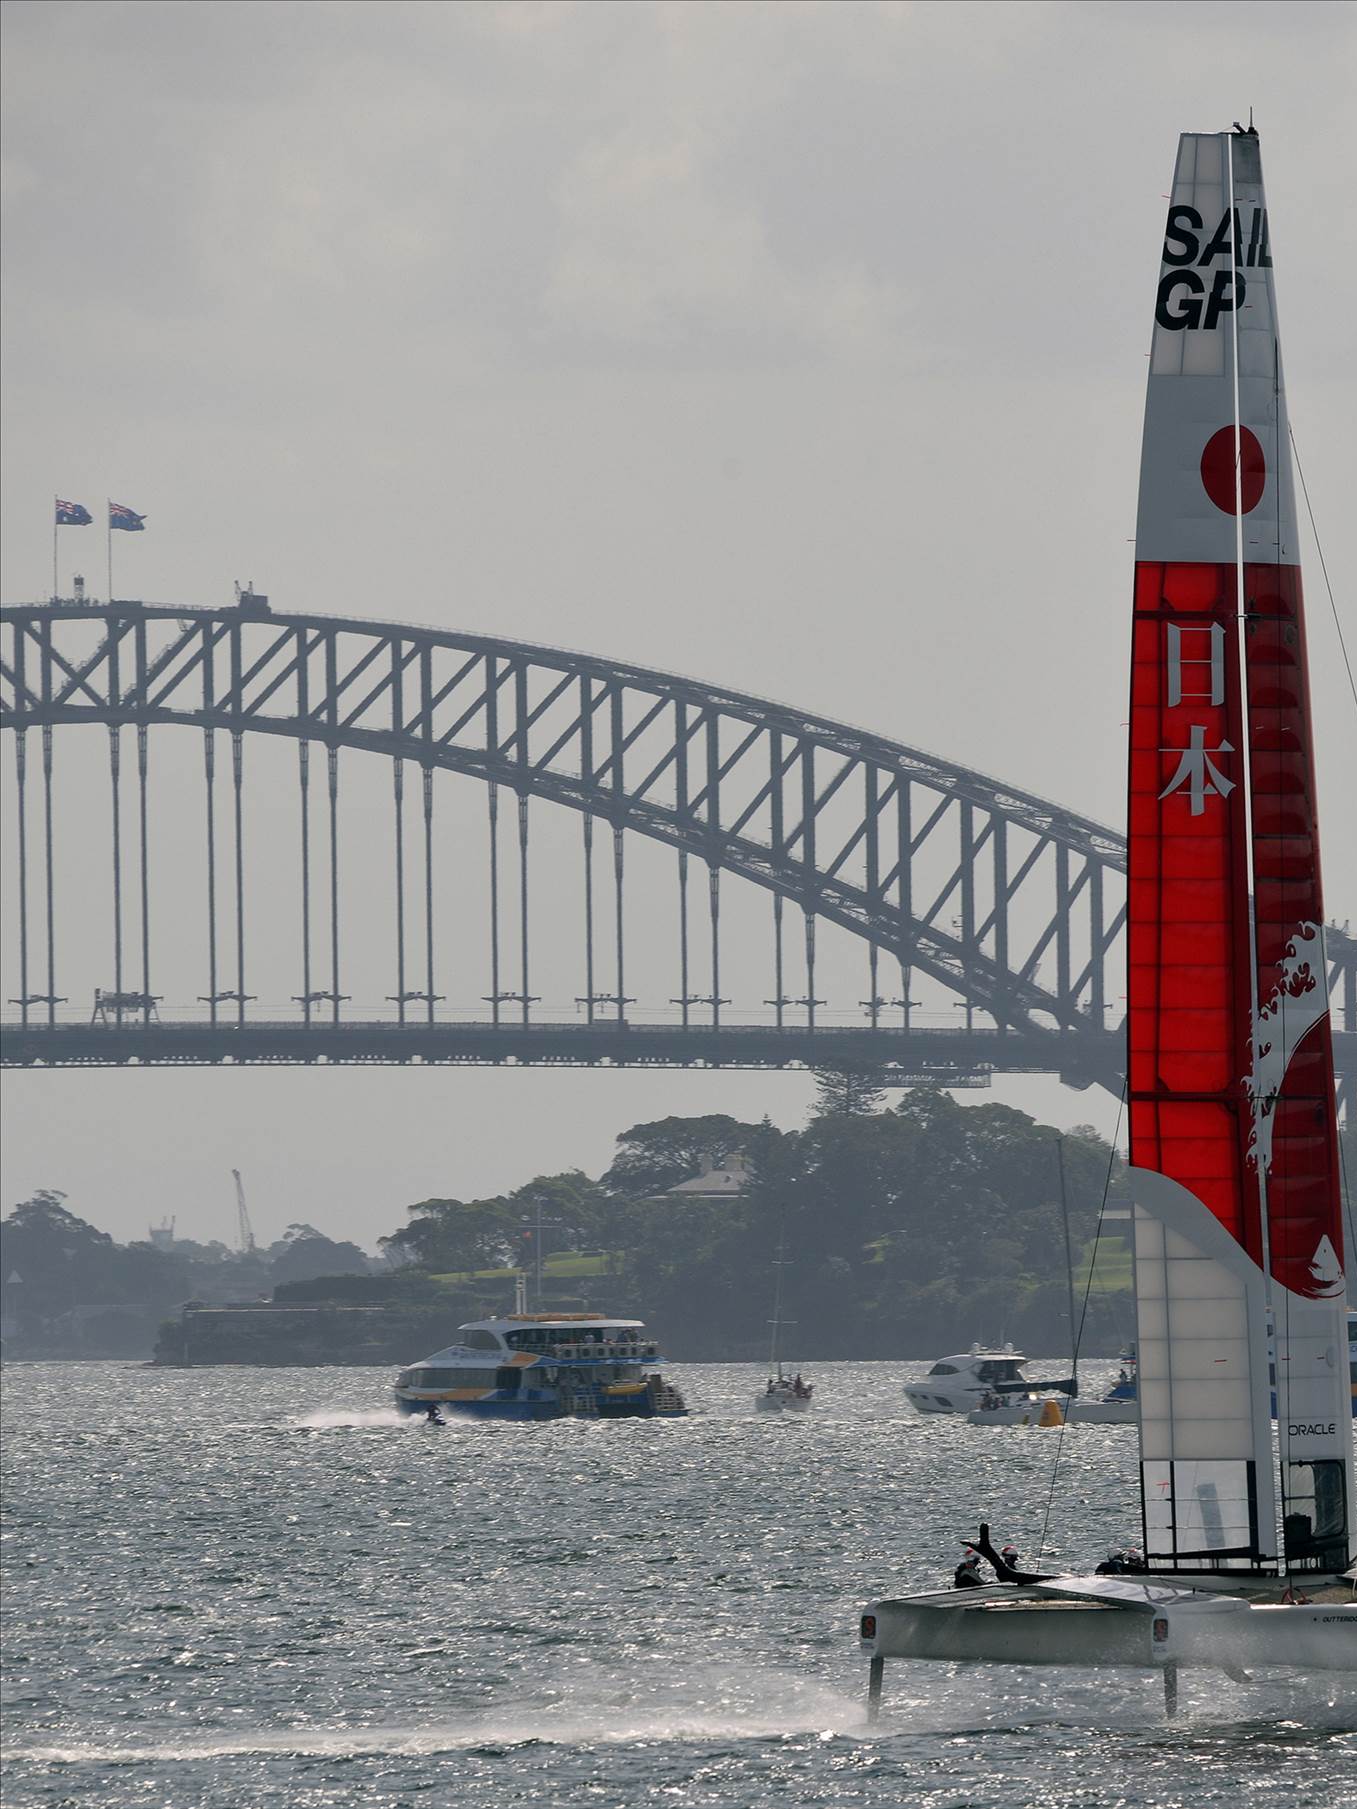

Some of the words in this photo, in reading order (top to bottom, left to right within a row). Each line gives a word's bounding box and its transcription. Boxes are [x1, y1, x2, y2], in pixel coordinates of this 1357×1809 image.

[1161, 205, 1273, 267] SAIL
[1155, 269, 1246, 331] GP
[1158, 621, 1236, 816] 日本
[1287, 1423, 1336, 1436] ORACLE
